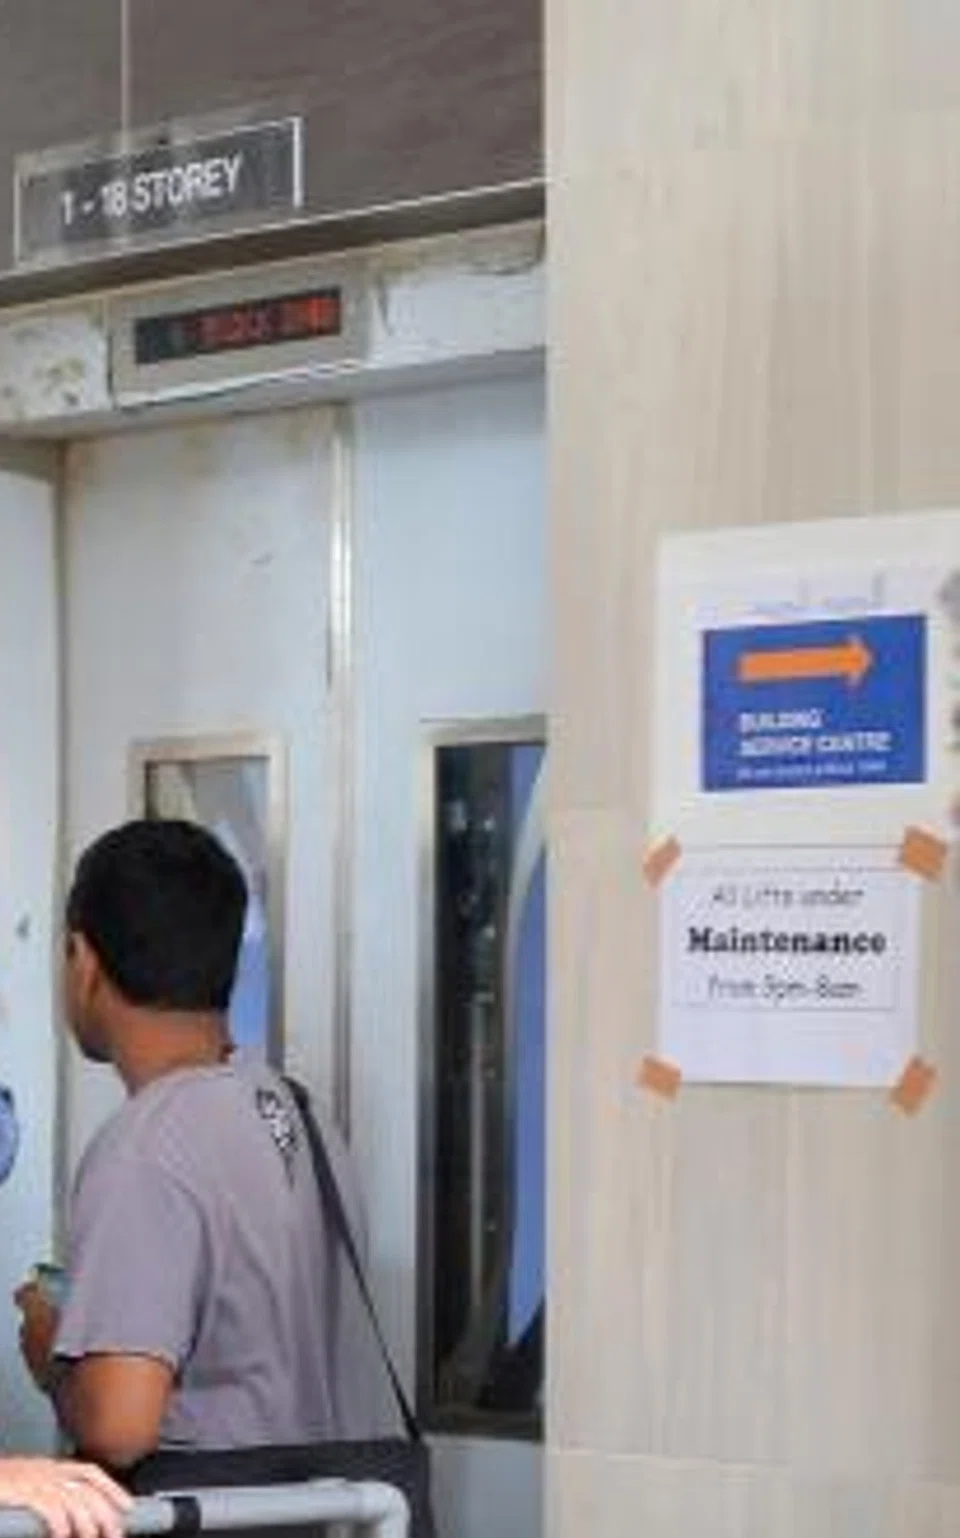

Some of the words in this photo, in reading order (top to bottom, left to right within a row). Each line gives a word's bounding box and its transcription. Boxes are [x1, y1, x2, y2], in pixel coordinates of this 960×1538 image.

[61, 190, 74, 225] 1
[101, 181, 128, 217] 18
[132, 154, 243, 212] STOREY
[686, 926, 887, 954] Maintenance
